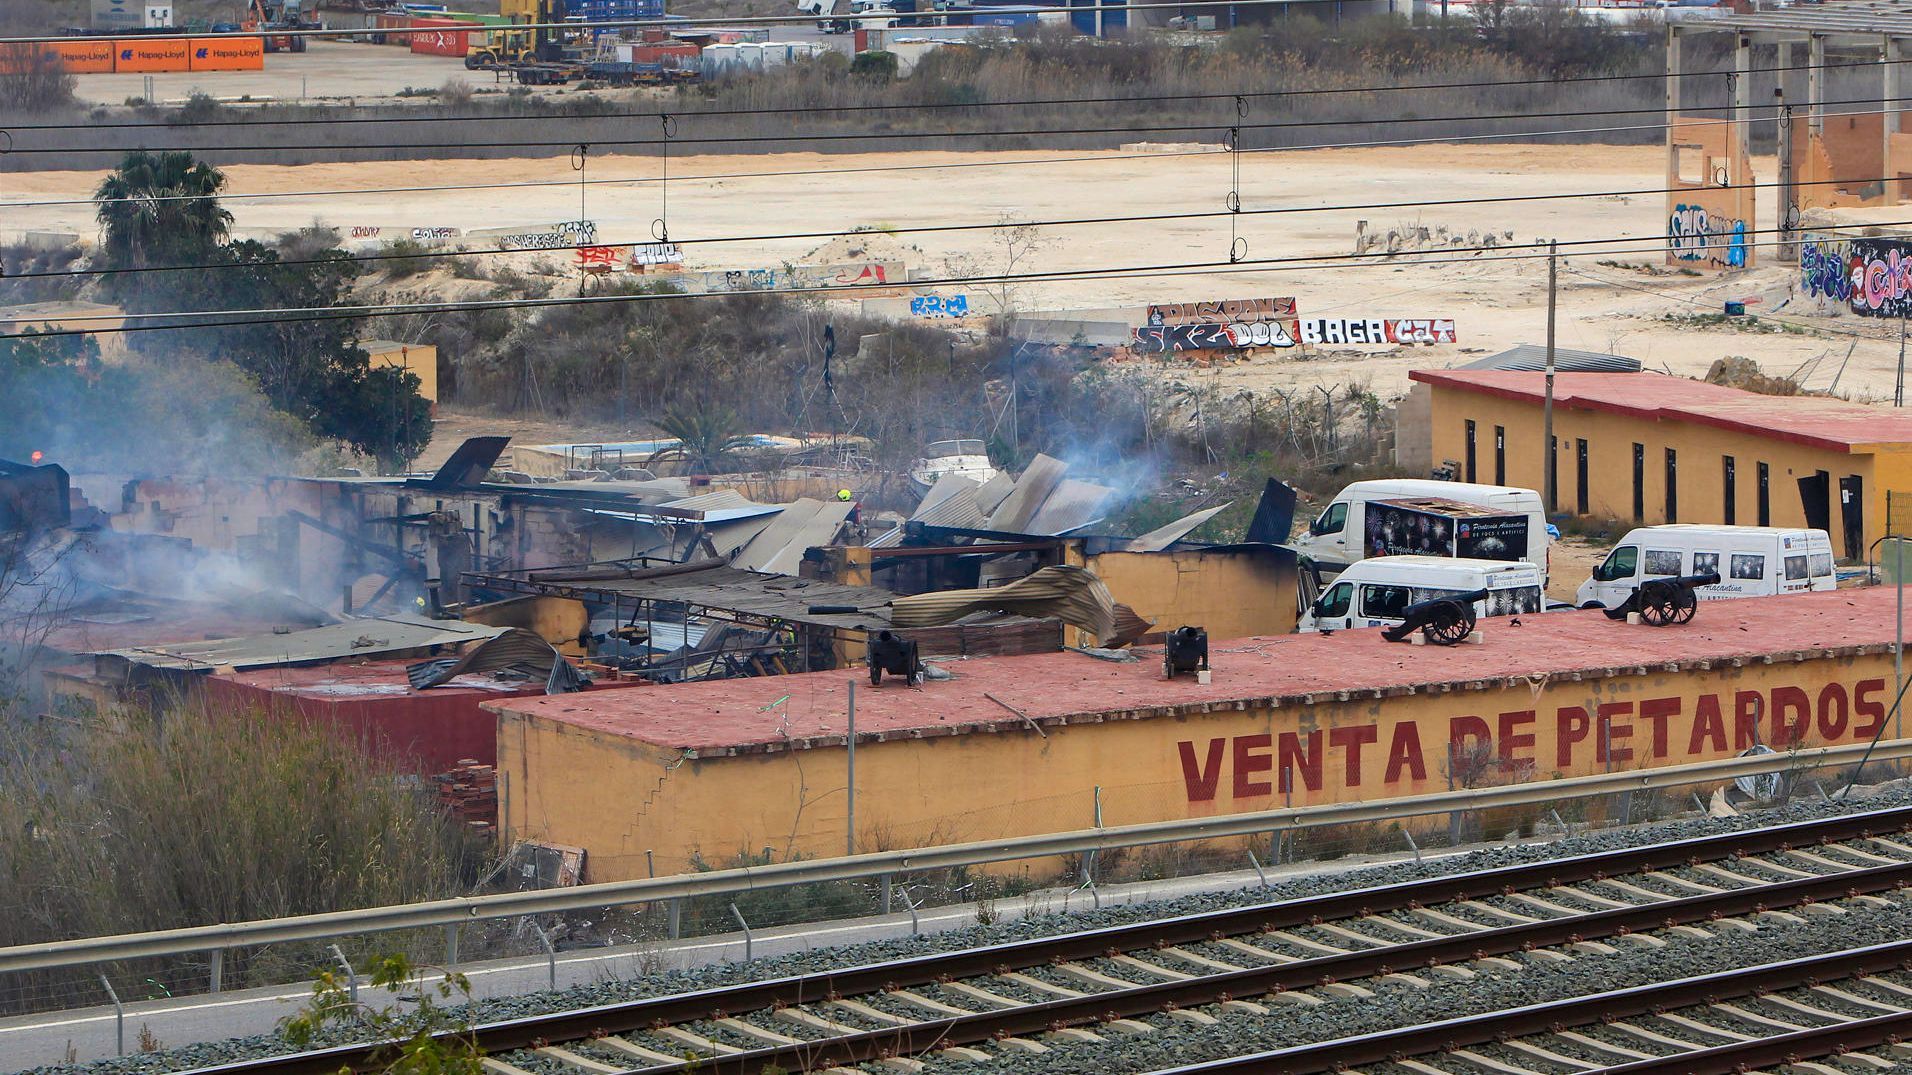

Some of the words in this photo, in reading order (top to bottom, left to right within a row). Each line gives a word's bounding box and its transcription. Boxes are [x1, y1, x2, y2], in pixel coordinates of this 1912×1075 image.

[61, 51, 109, 61] Hapag-Lloyd
[138, 50, 185, 60] Hapag-Lloyd
[213, 49, 260, 59] Hapag-Lloyd
[1177, 720, 1427, 802] VENTA
[1449, 710, 1536, 778] DE
[1557, 678, 1886, 768] PETARDOS
